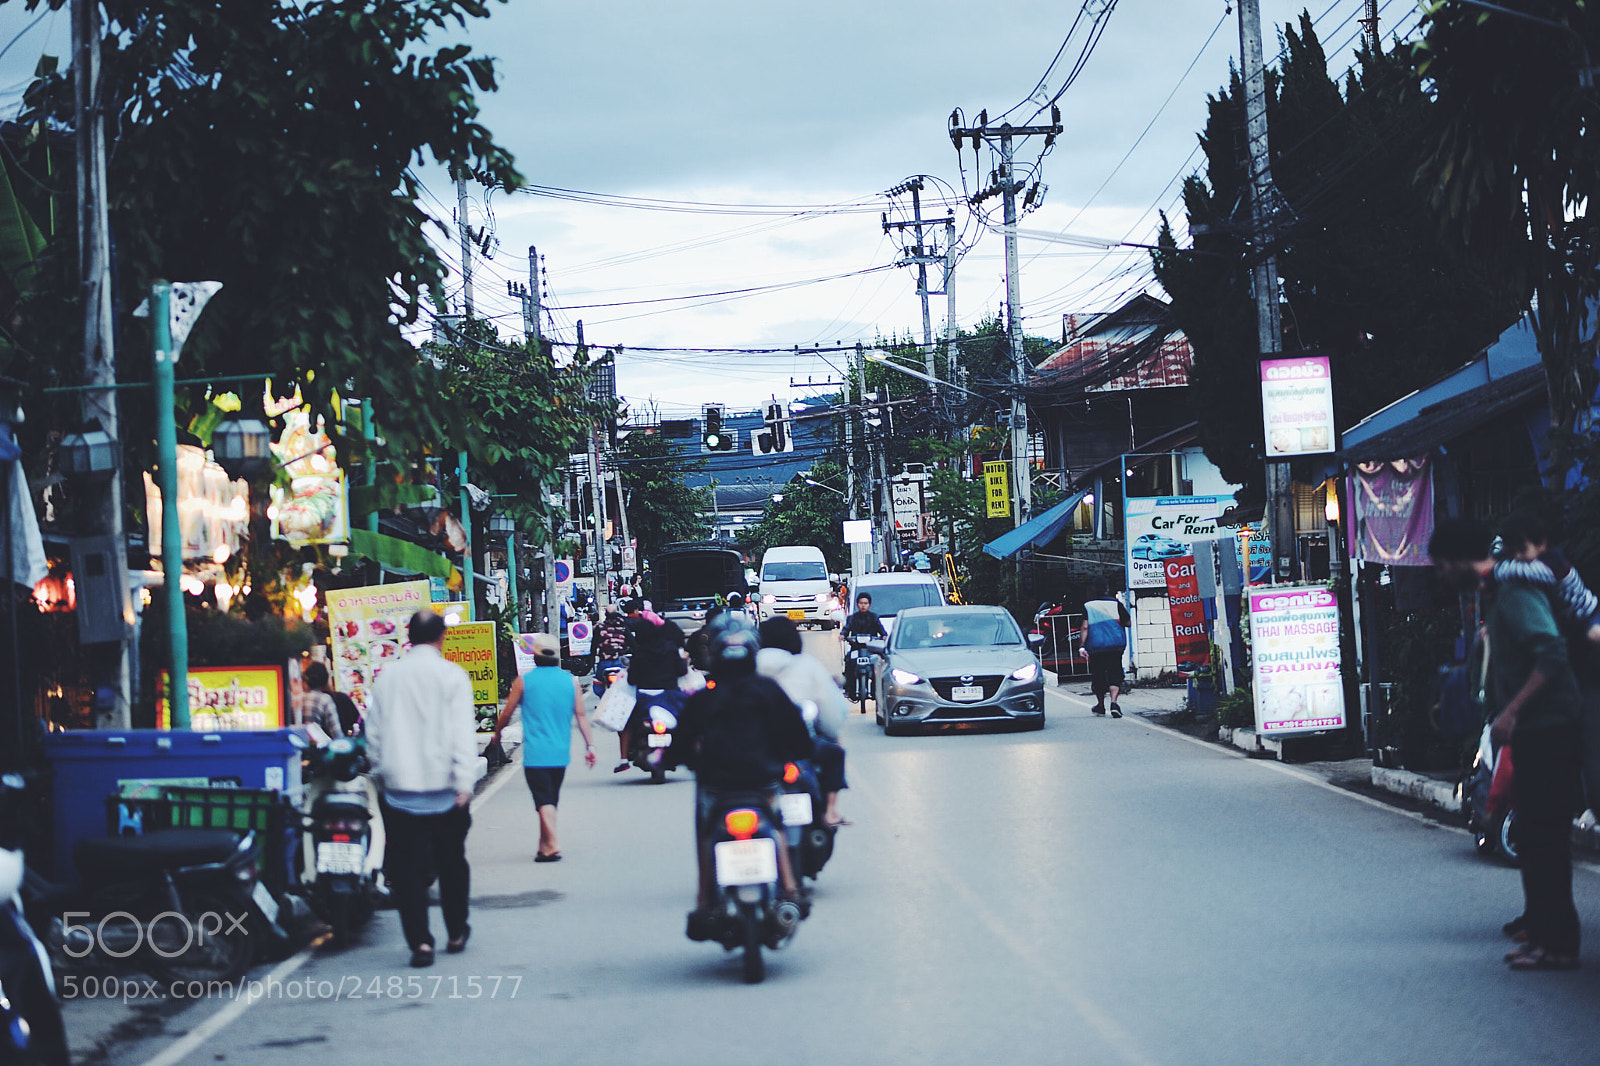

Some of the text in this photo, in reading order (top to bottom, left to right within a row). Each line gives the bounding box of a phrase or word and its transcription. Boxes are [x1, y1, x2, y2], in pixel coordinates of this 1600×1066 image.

[1266, 361, 1325, 379] ดอกบัว
[985, 464, 1005, 473] MOTOR
[990, 476, 1003, 485] BIKE
[992, 489, 1002, 497] FOR
[991, 501, 1005, 509] RENT
[1152, 516, 1175, 530] Car
[1177, 514, 1200, 525] For
[1183, 524, 1216, 535] Rent
[1133, 562, 1153, 571] Open
[1167, 563, 1196, 578] Car
[1259, 591, 1333, 609] ดอกบัว
[1175, 622, 1205, 637] Rent
[1256, 622, 1338, 638] THAI MASSAGE
[1258, 646, 1339, 663] อบสมุนไพร
[1260, 661, 1338, 674] SAUNA
